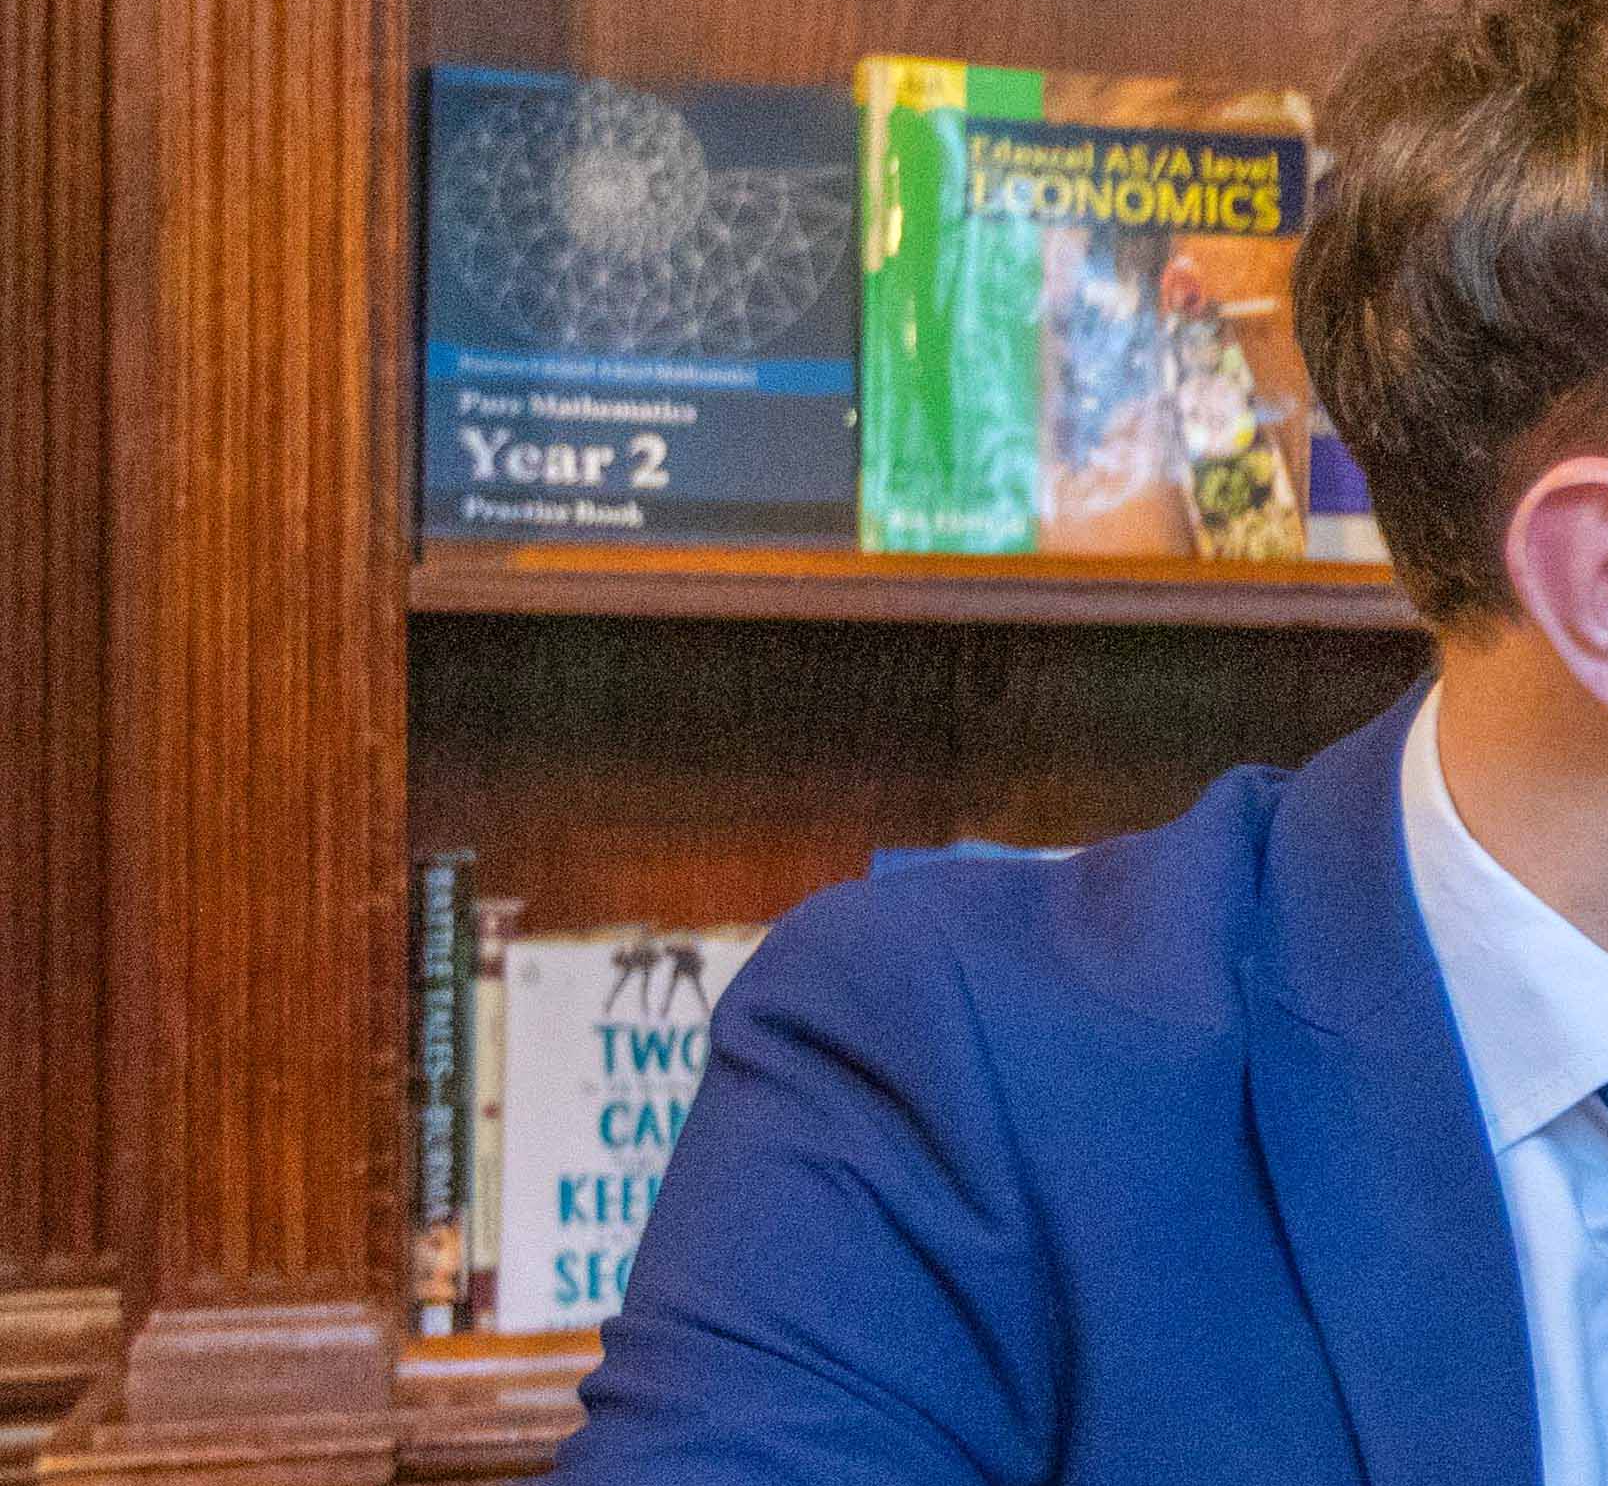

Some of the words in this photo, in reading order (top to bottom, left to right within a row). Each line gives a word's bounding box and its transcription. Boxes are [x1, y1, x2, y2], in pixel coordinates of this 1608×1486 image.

[1105, 143, 1193, 181] AS/A
[1199, 149, 1280, 188] level
[972, 170, 1283, 233] ECONOMICS
[458, 389, 523, 417] Pure
[531, 393, 700, 424] Mathematics
[460, 427, 616, 487] Year
[630, 433, 672, 489] 2
[463, 495, 570, 531] Practice
[575, 497, 645, 529] Book
